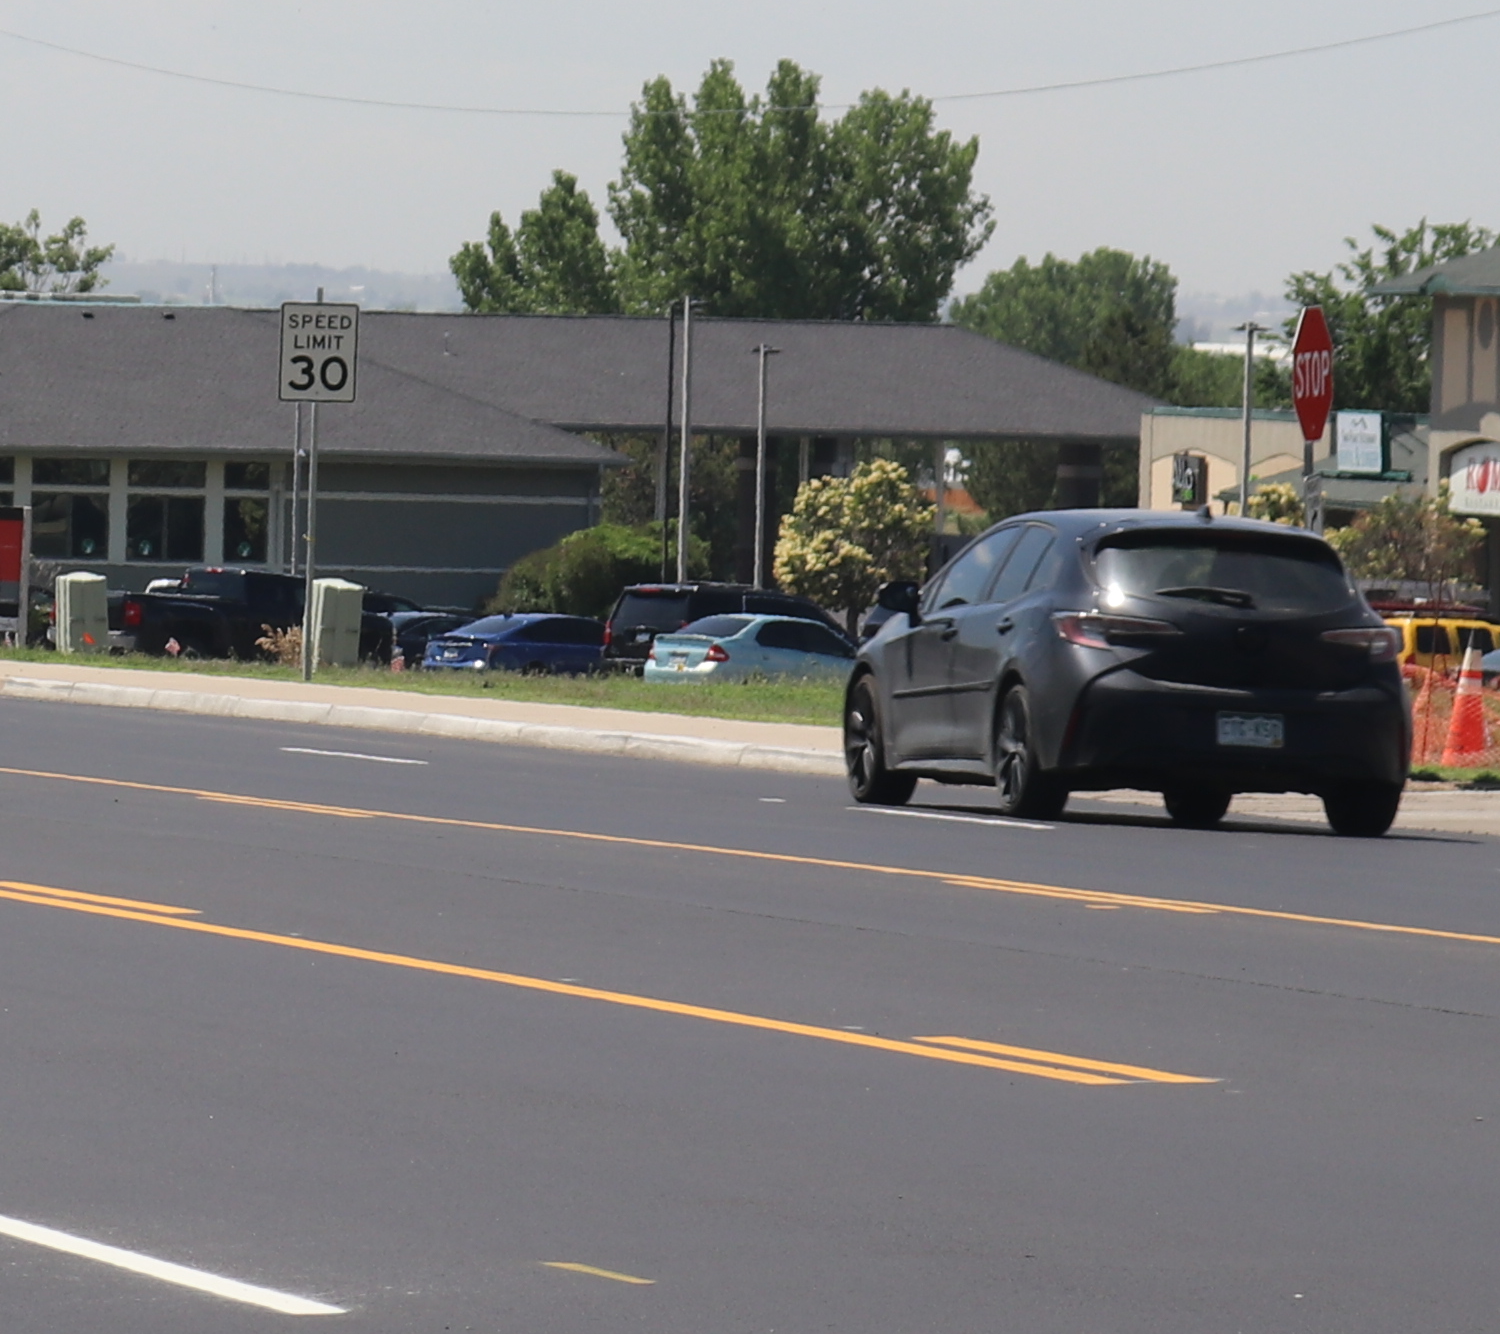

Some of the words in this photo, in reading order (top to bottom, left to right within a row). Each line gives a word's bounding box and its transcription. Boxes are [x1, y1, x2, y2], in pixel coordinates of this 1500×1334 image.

[288, 313, 352, 330] SPEED
[293, 334, 344, 350] LIMIT
[288, 355, 348, 392] 30
[1295, 349, 1330, 399] STOP
